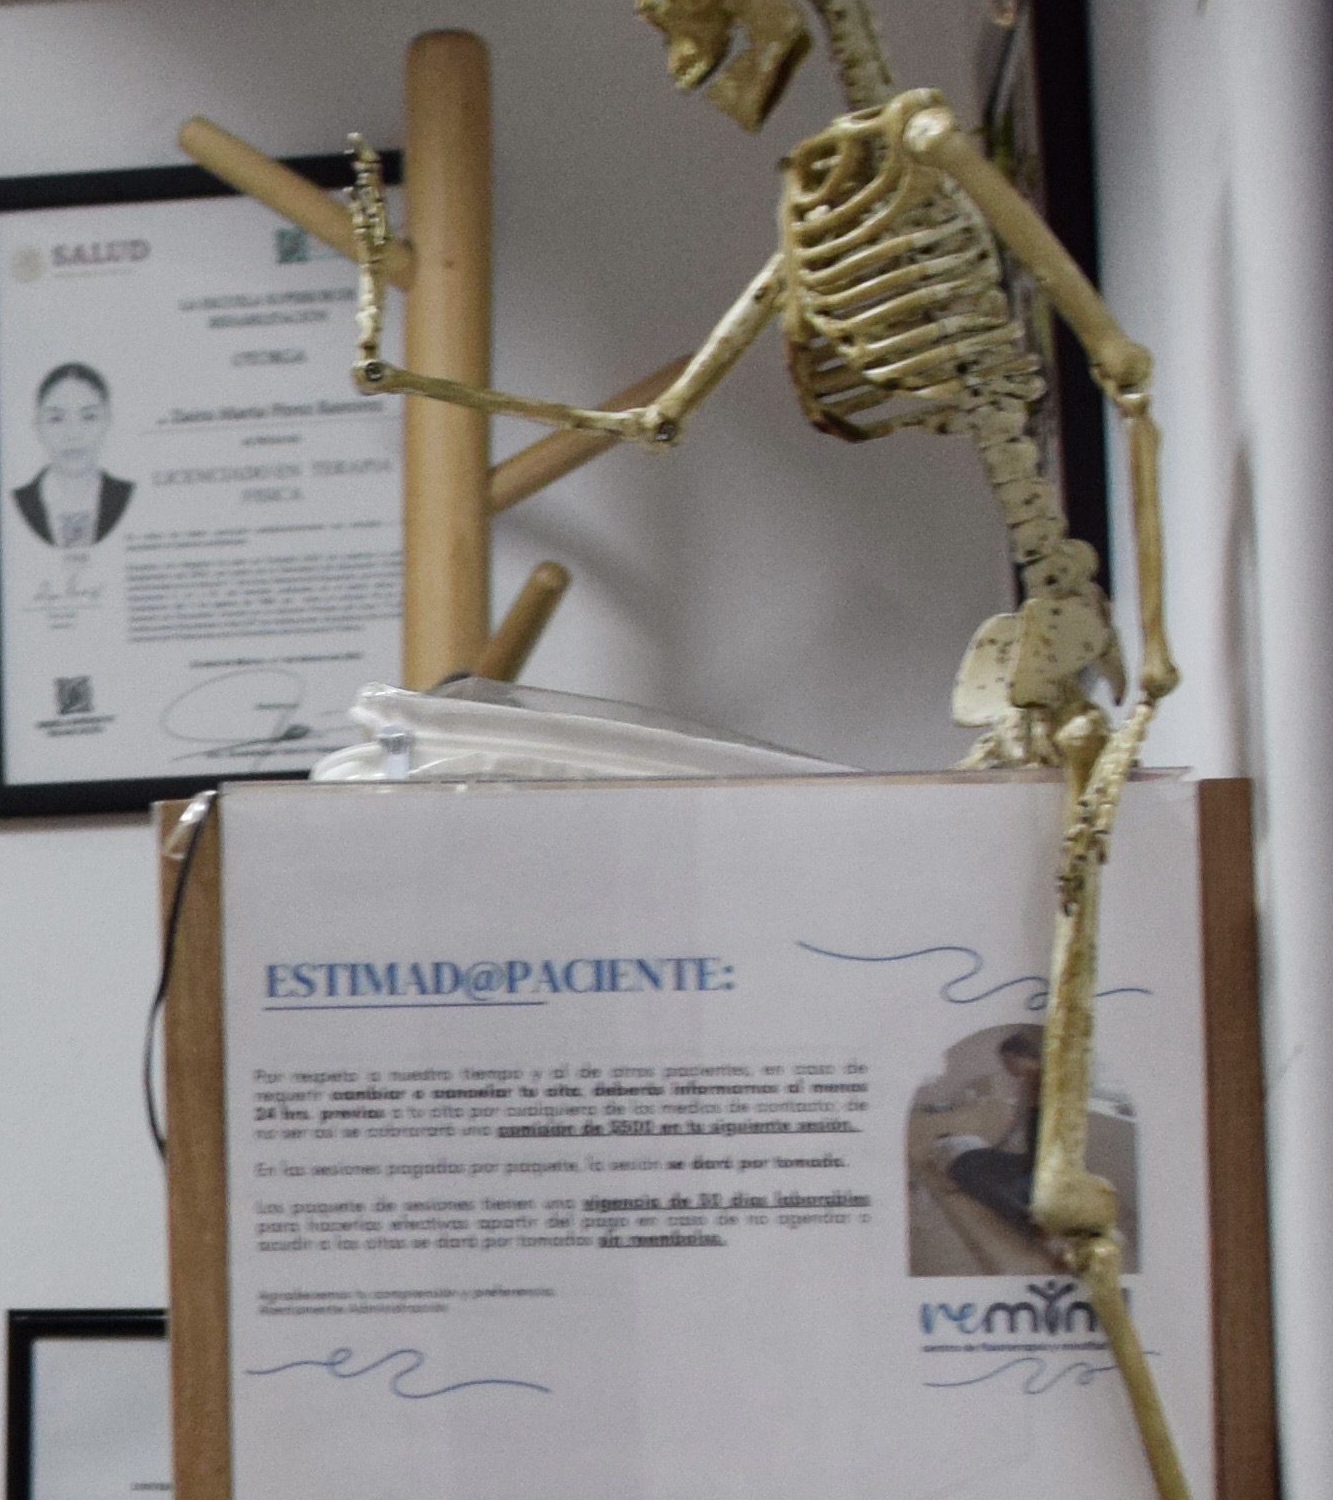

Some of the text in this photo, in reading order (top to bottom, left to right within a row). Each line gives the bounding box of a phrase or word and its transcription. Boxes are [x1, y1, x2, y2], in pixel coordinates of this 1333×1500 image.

[51, 239, 151, 266] SALUD
[462, 1066, 523, 1083] tiempo
[920, 1279, 1132, 1335] remin
